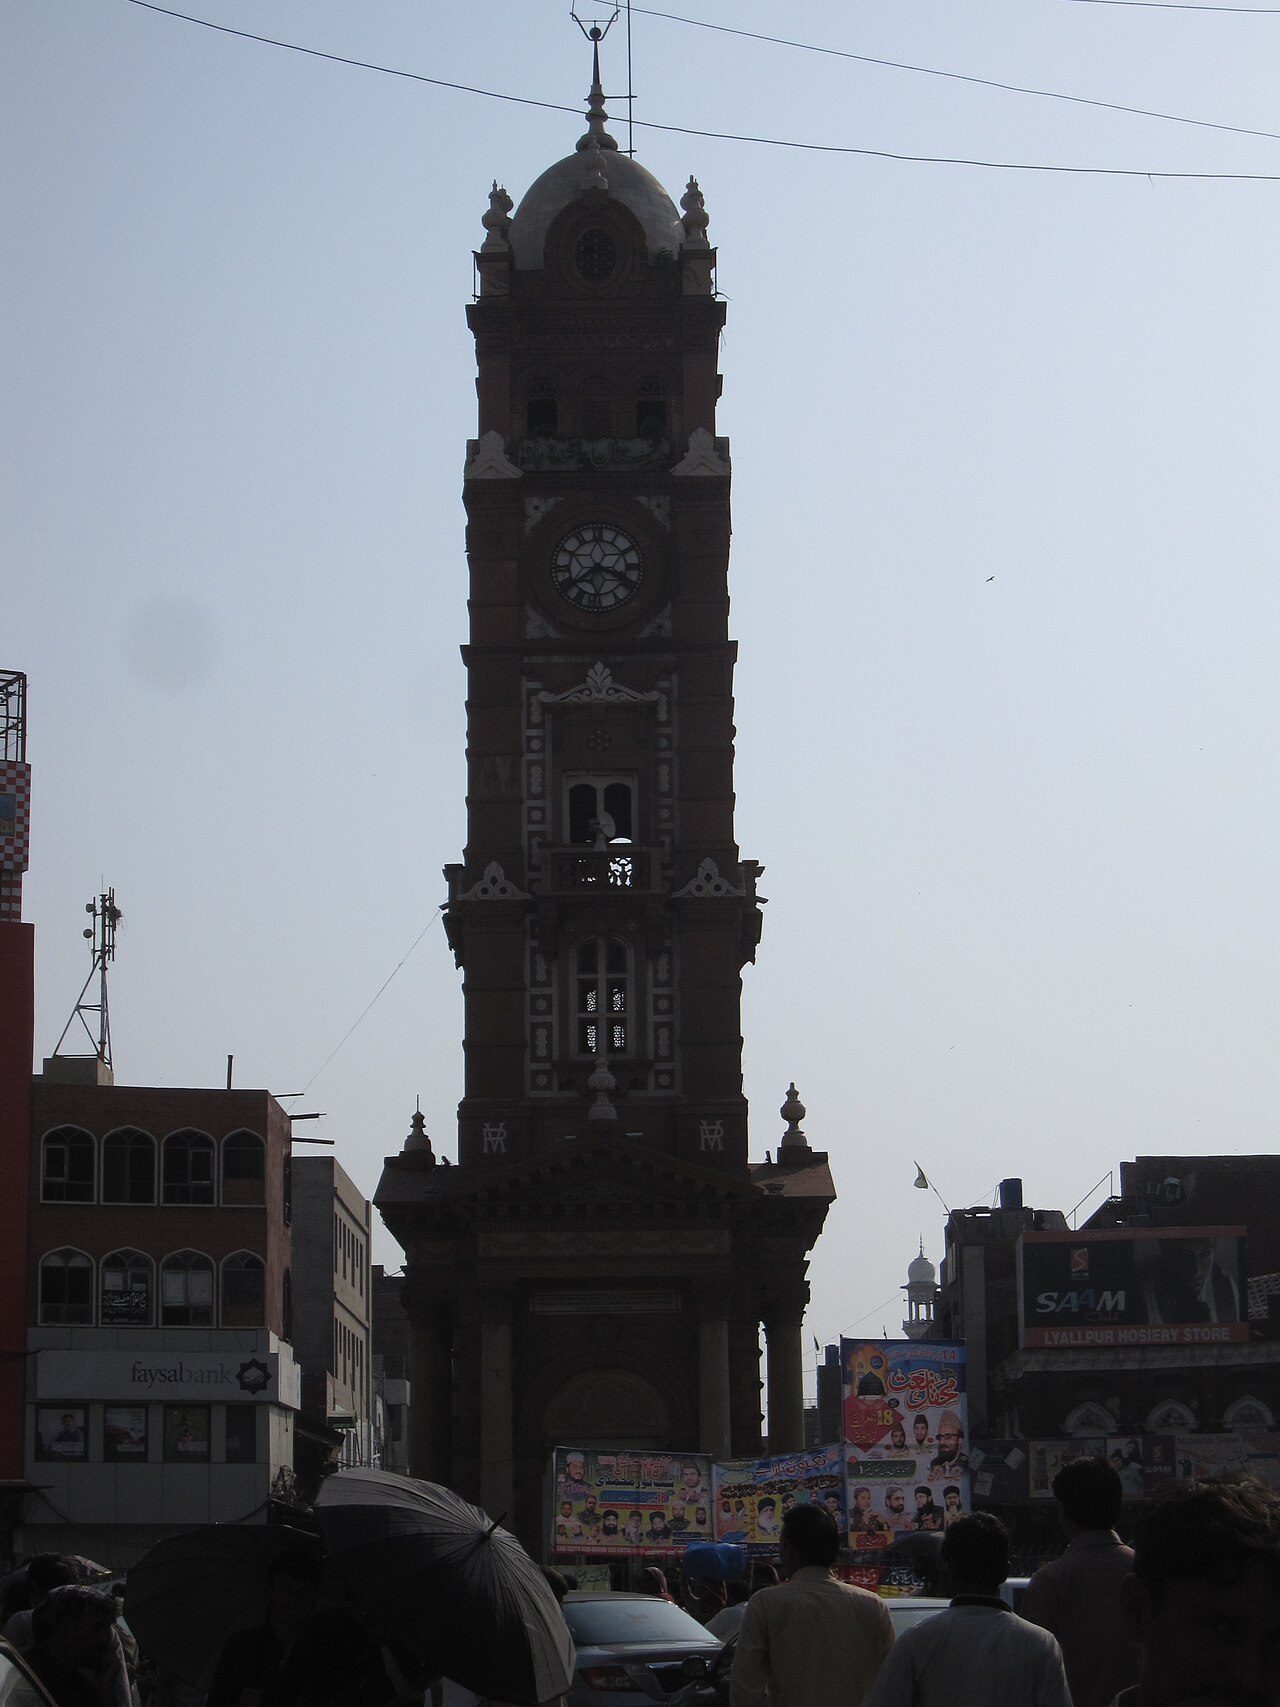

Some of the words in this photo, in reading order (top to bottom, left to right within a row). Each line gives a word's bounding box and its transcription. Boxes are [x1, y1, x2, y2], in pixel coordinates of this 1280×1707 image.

[1036, 1288, 1126, 1313] SAAM
[1043, 1330, 1113, 1345] LYALLPUR
[1117, 1328, 1178, 1343] HOSIERY
[1183, 1327, 1230, 1342] STORE
